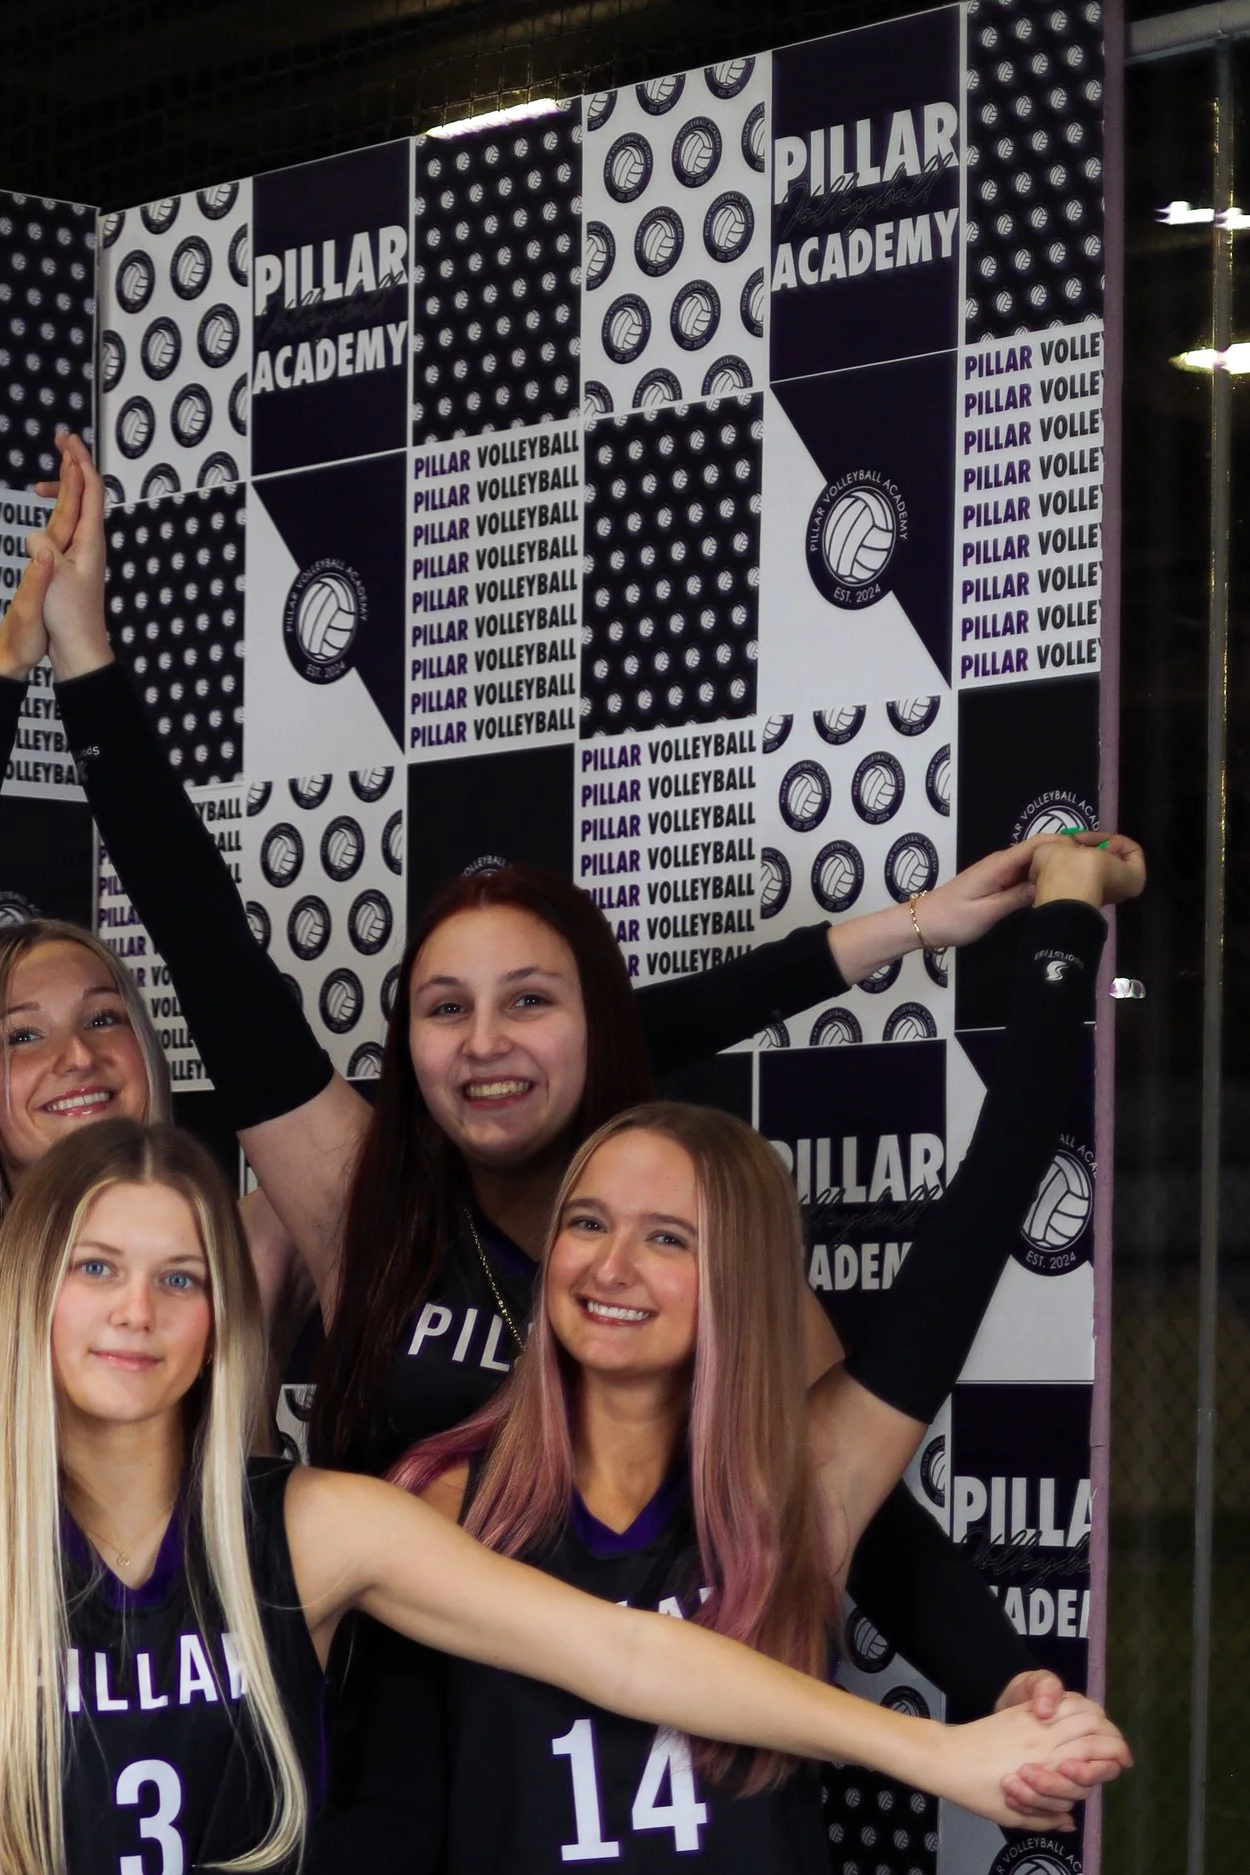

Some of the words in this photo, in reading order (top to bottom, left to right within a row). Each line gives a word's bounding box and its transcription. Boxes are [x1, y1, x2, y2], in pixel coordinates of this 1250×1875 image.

[774, 101, 959, 205] PILLAR
[772, 207, 959, 292] ACADEMY
[254, 225, 408, 316] PILLAR
[252, 320, 408, 395] ACADEMY
[965, 345, 1032, 380] PILLAR
[964, 383, 1032, 417] PILLAR
[415, 450, 470, 479] PILLAR
[477, 430, 579, 468] VOLLEYBALL
[964, 420, 1031, 455] PILLAR
[414, 483, 470, 513] PILLAR
[477, 465, 578, 502] VOLLEYBALL
[964, 458, 1030, 492] PILLAR
[414, 517, 469, 547] PILLAR
[477, 499, 578, 536] VOLLEYBALL
[810, 506, 826, 552] PILLAR
[822, 470, 882, 503] VOLLEYBALL
[882, 478, 910, 540] ACADEMY
[963, 496, 1030, 529] PILLAR
[413, 551, 469, 580] PILLAR
[476, 534, 577, 570] VOLLEYBALL
[962, 534, 1030, 567] PILLAR
[413, 585, 468, 614] PILLAR
[476, 569, 577, 604] VOLLEYBALL
[962, 572, 1029, 604] PILLAR
[412, 619, 468, 648] PILLAR
[475, 603, 577, 638] VOLLEYBALL
[962, 609, 1028, 641] PILLAR
[412, 653, 467, 681] PILLAR
[475, 638, 576, 672] VOLLEYBALL
[961, 647, 1028, 679] PILLAR
[411, 687, 467, 715] PILLAR
[474, 673, 576, 706] VOLLEYBALL
[411, 721, 466, 748] PILLAR
[474, 708, 575, 740] VOLLEYBALL
[582, 744, 642, 772] PILLAR
[649, 730, 756, 764] VOLLEYBALL
[582, 779, 641, 807] PILLAR
[648, 766, 756, 799] VOLLEYBALL
[1020, 790, 1077, 820] VOLLEYBALL
[582, 814, 641, 842] PILLAR
[648, 802, 755, 835] VOLLEYBALL
[581, 850, 640, 876] PILLAR
[648, 837, 755, 870] VOLLEYBALL
[647, 873, 755, 905] VOLLEYBALL
[647, 909, 754, 940] VOLLEYBALL
[952, 1475, 1092, 1547] PILLA
[552, 1718, 708, 1862] 14
[1002, 1838, 1066, 1863] VOLLEYBALL
